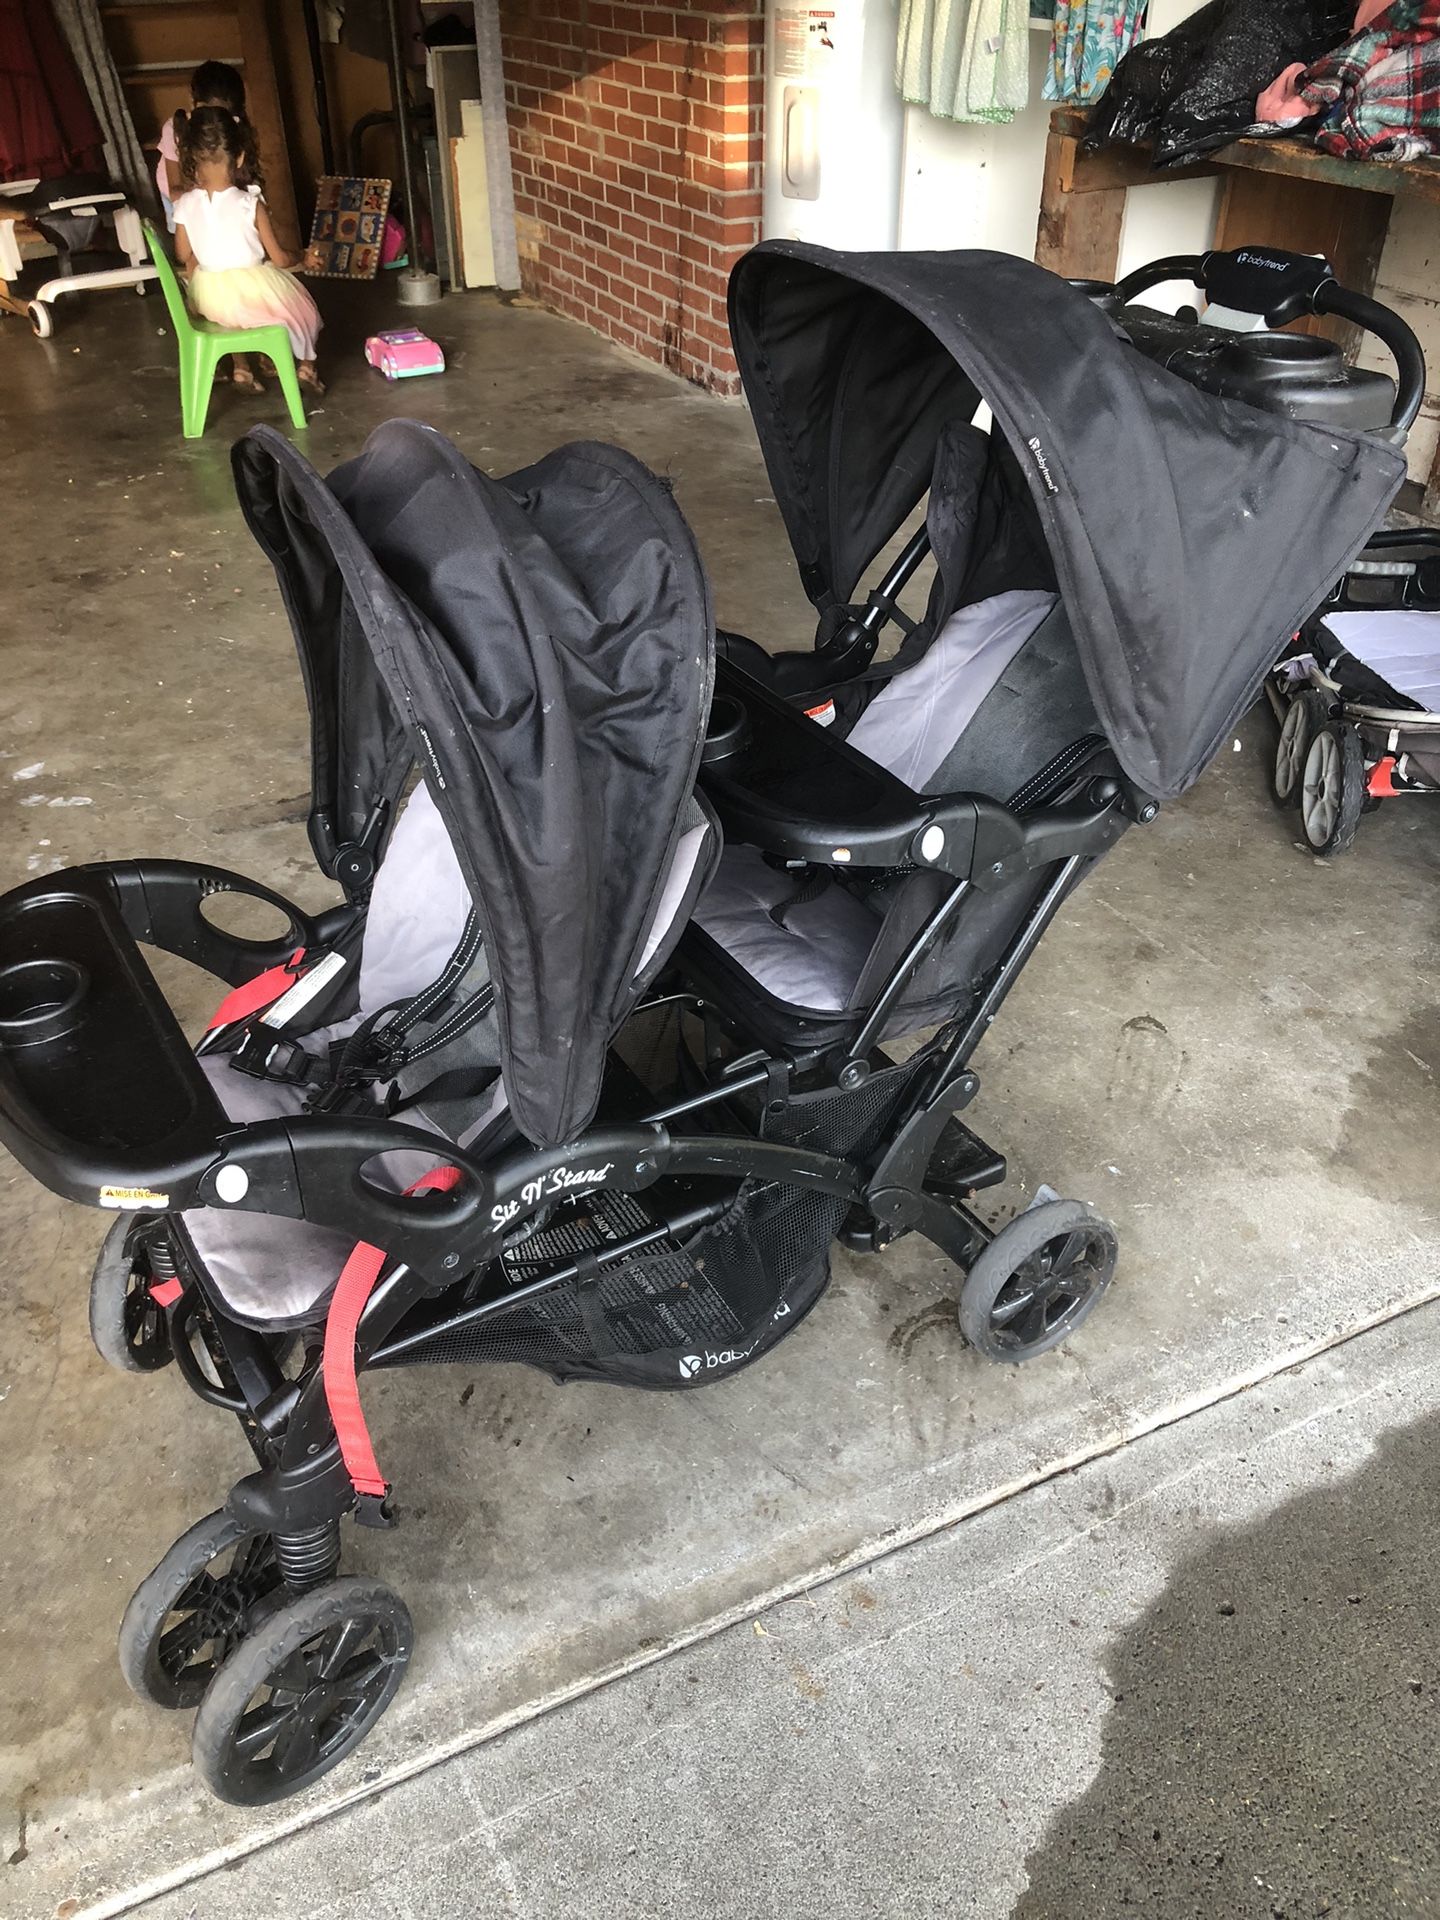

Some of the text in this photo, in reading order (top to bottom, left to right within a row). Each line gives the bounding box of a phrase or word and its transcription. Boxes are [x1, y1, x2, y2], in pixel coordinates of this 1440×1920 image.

[1247, 255, 1290, 271] babytrend
[1034, 449, 1058, 492] babytrend
[491, 1199, 521, 1233] Sit
[546, 1163, 611, 1195] Stand
